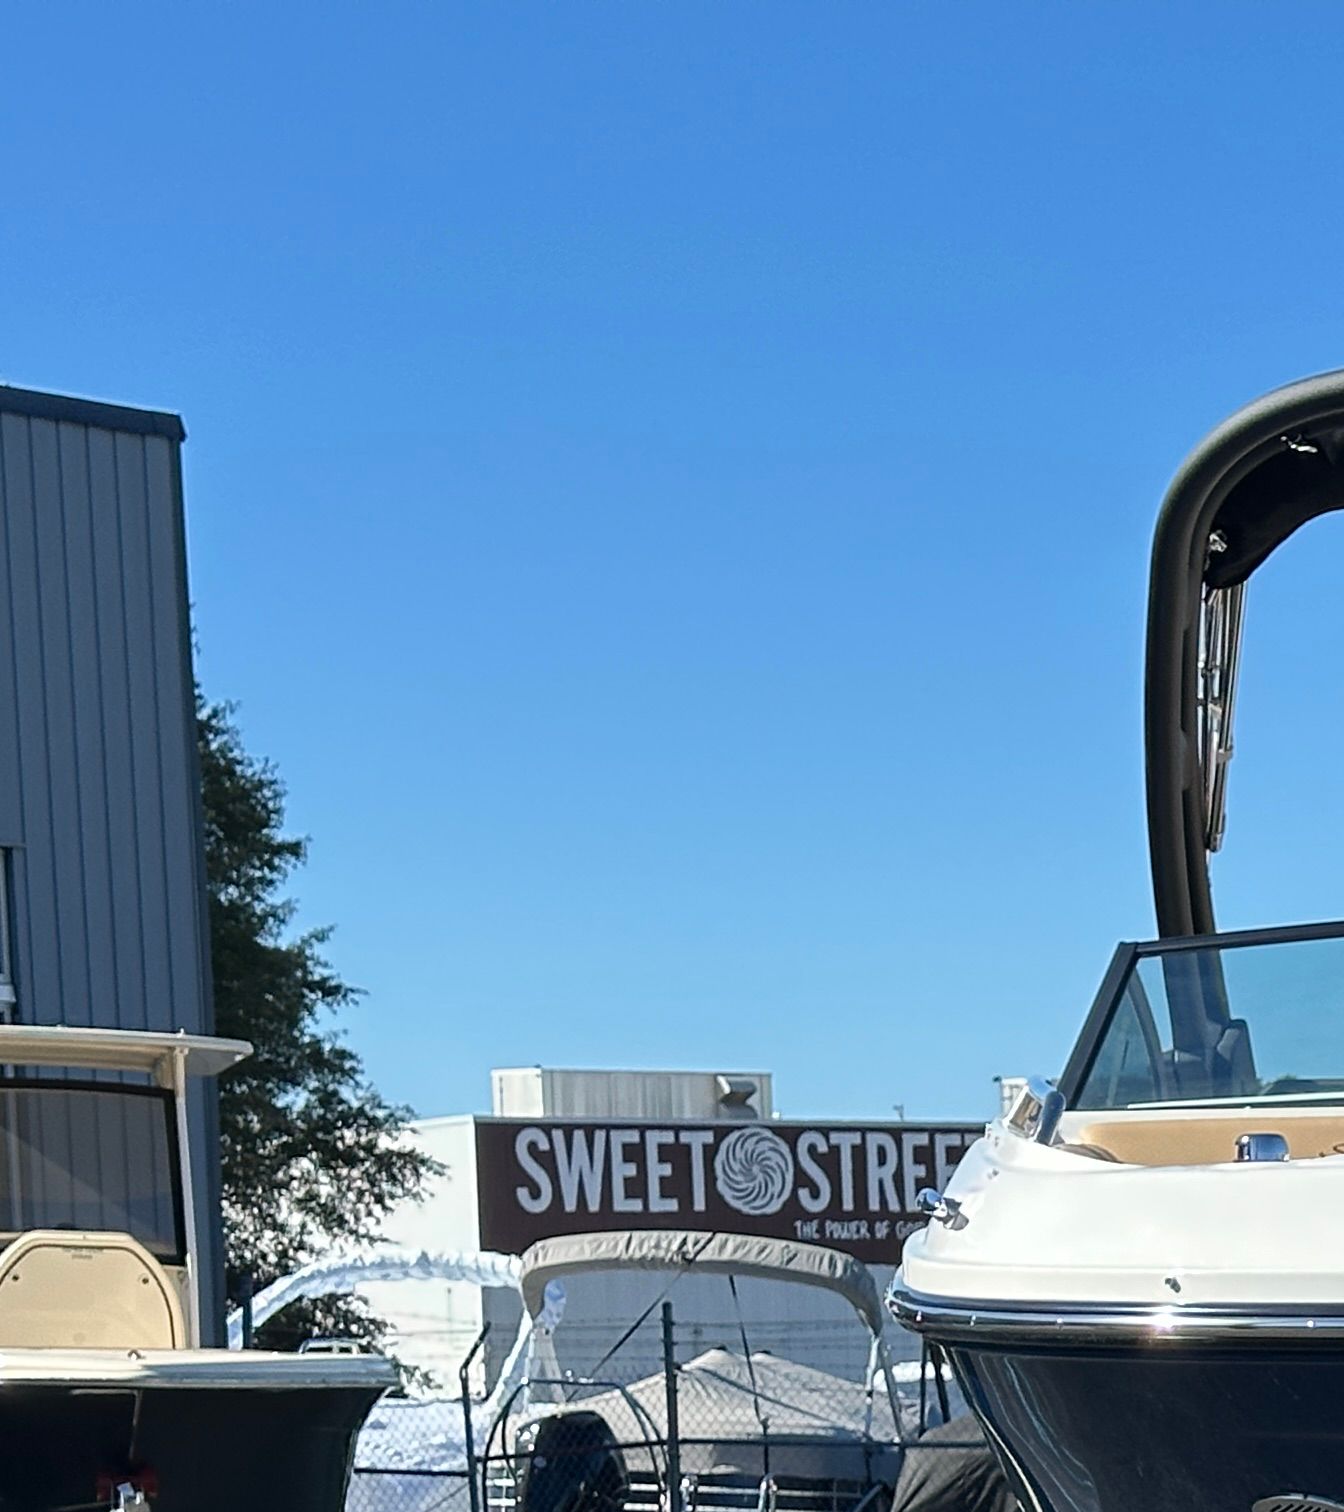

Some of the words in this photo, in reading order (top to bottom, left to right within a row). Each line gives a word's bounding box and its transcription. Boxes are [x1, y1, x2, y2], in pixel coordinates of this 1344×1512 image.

[515, 1127, 715, 1213] SWEET
[797, 1129, 985, 1213] STREE
[793, 1219, 821, 1240] THE
[825, 1219, 871, 1240] POWER
[874, 1219, 891, 1240] OF
